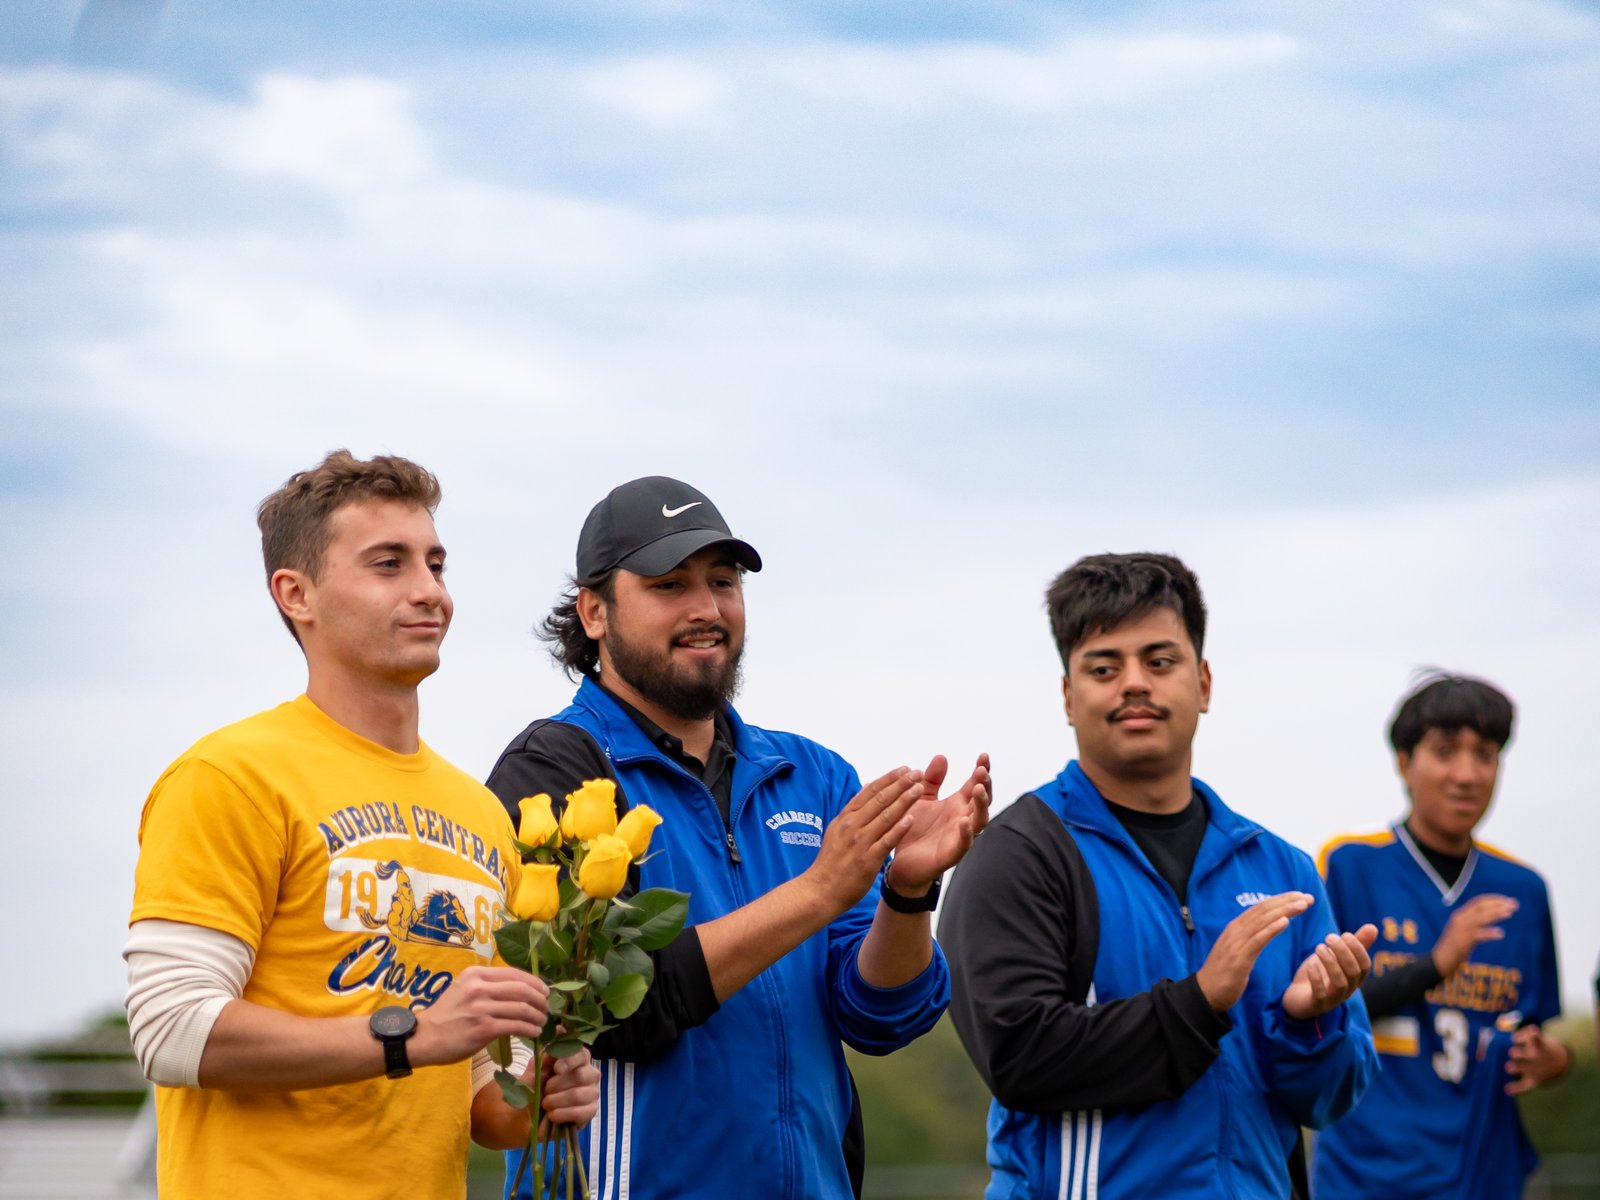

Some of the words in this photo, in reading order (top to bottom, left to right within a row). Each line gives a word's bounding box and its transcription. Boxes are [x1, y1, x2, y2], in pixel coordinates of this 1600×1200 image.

[317, 802, 411, 859] AURORA
[780, 831, 821, 847] SOCCER
[338, 870, 378, 920] 19
[1432, 1009, 1469, 1084] 3
